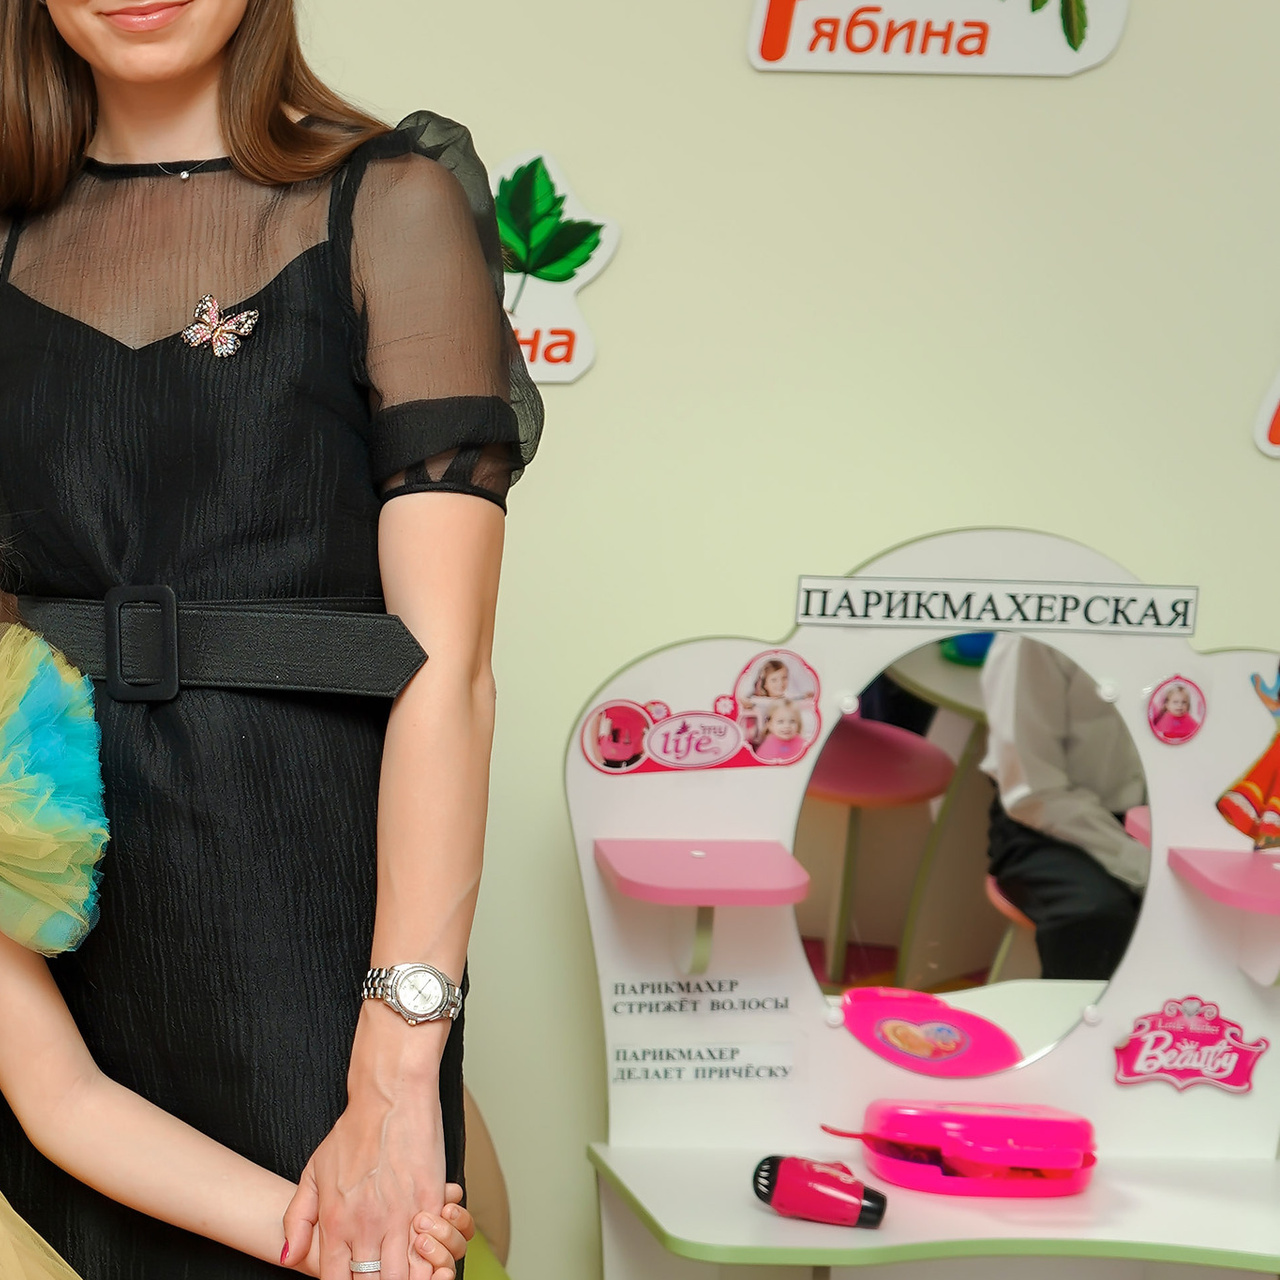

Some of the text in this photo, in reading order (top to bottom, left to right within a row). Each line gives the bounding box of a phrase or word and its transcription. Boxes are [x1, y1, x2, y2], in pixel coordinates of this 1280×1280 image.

[513, 327, 577, 364] на
[800, 587, 1195, 628] ПАРИКМАХЕРСКАЯ
[662, 729, 720, 760] life
[613, 979, 739, 996] ПАРИКМАХЕР
[612, 996, 790, 1015] СТРИЖЁТ ВОЛОСЫ
[614, 1047, 740, 1062] ПАРИКМАХЕР
[1133, 1030, 1239, 1079] Beauty
[612, 1063, 793, 1081] ДЕЛАЕТ ПРИЧЁСКУ
